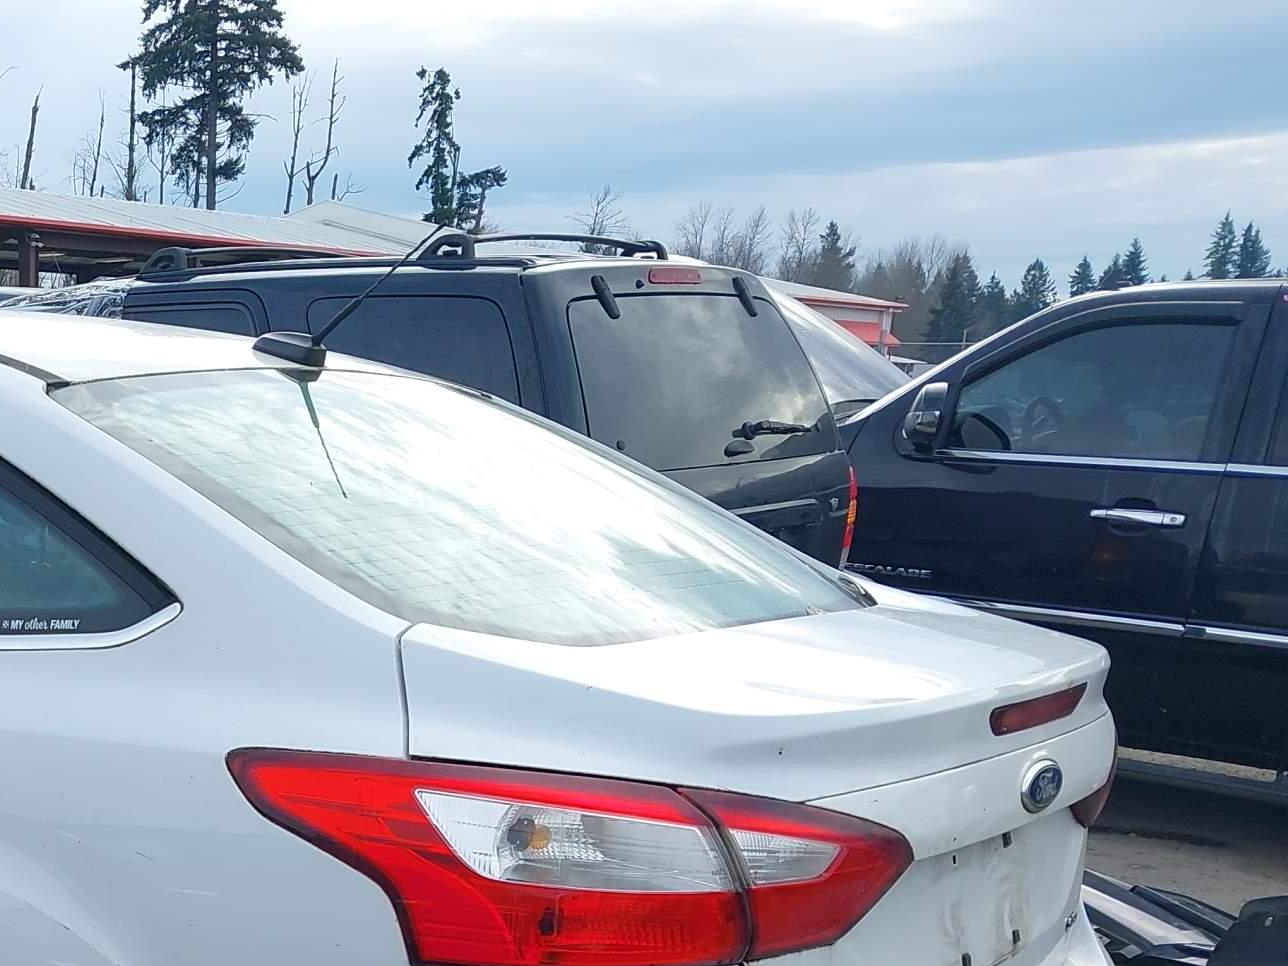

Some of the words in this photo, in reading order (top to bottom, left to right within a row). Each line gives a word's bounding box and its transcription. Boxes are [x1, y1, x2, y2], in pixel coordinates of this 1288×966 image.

[10, 620, 24, 630] MY
[24, 616, 49, 630] other
[50, 619, 80, 630] FAMILY
